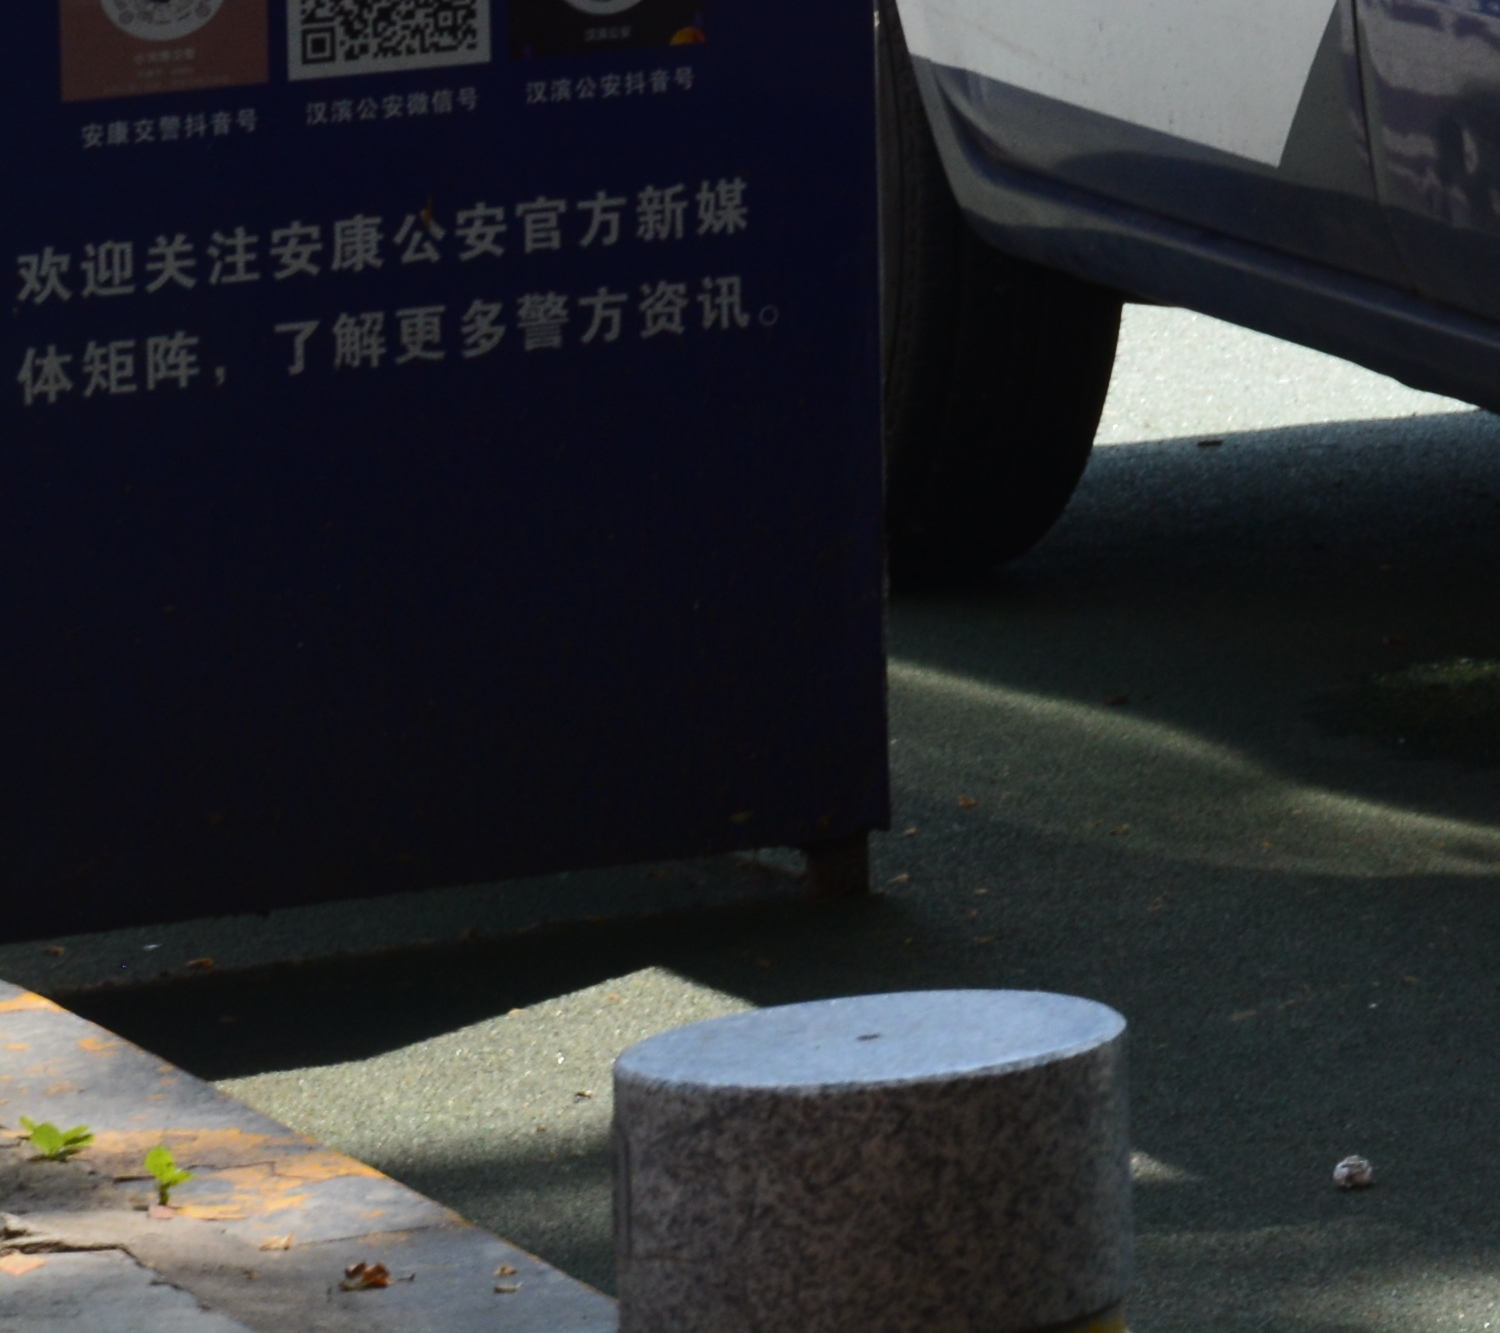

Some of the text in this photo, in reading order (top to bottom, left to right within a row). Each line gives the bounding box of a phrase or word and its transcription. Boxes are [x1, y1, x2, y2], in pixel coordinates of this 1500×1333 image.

[304, 86, 479, 127] 汉滨公安微信号
[525, 65, 695, 106] 汉滨公安抖音号
[80, 107, 259, 150] 安康交警抖音号
[15, 175, 750, 305] 欢迎关注安康公安官方新媒
[16, 274, 780, 406] 体矩阵，了解更多警方资讯。
